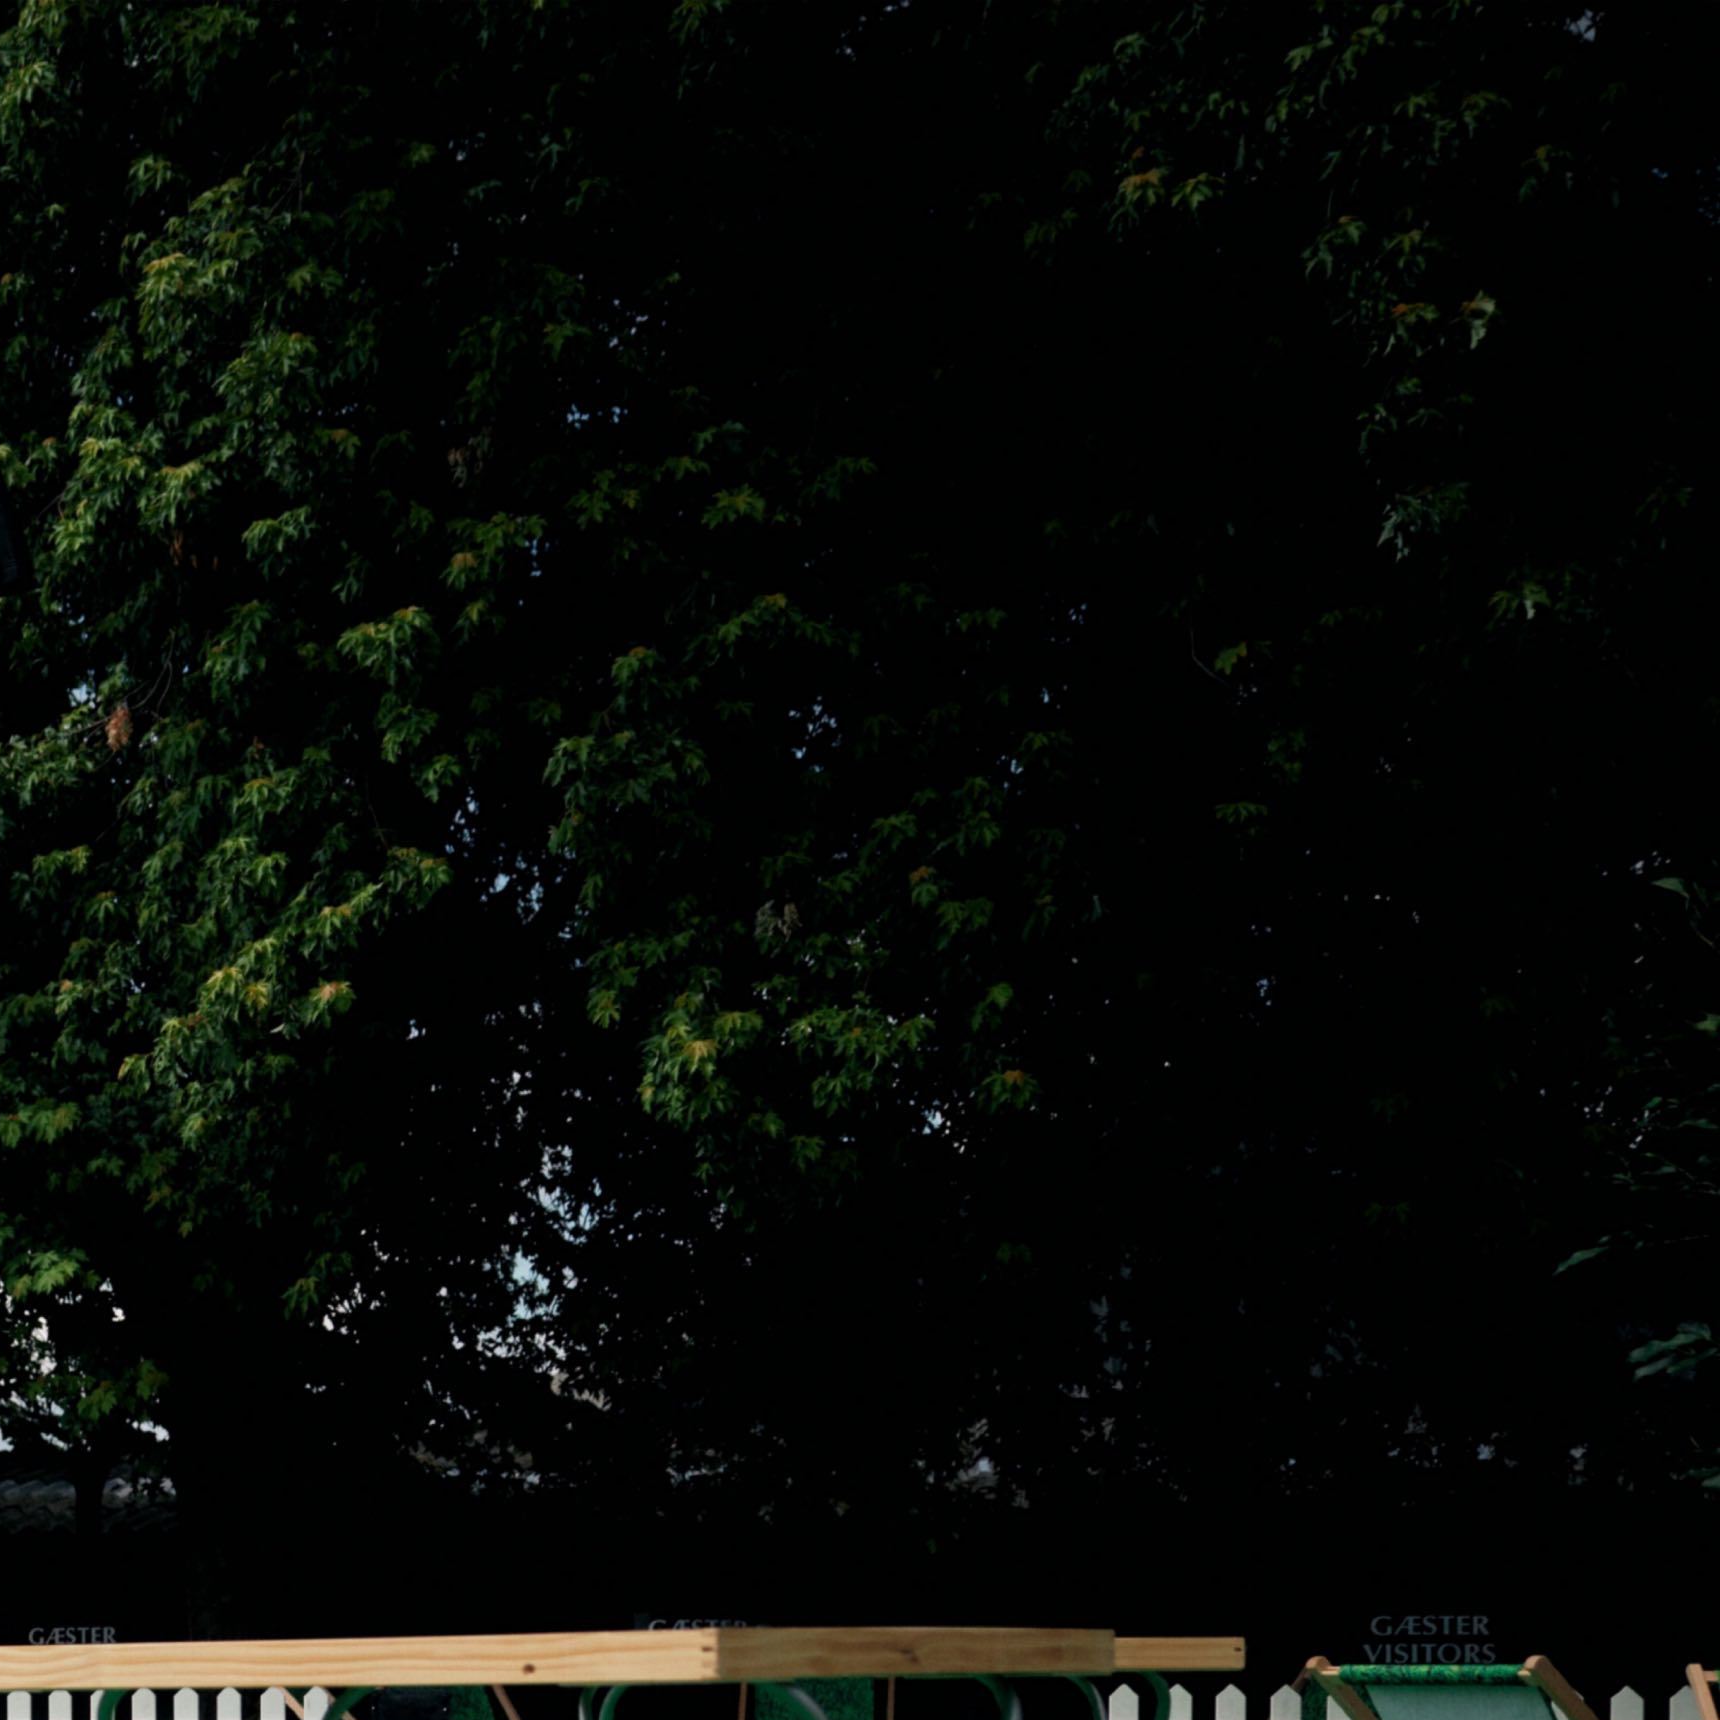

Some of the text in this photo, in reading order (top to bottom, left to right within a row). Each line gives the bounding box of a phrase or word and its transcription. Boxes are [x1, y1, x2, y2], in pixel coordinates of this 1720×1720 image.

[28, 1626, 118, 1645] GÆSTER
[1370, 1615, 1490, 1637] GÆSTER
[1362, 1643, 1497, 1665] VISITORS
